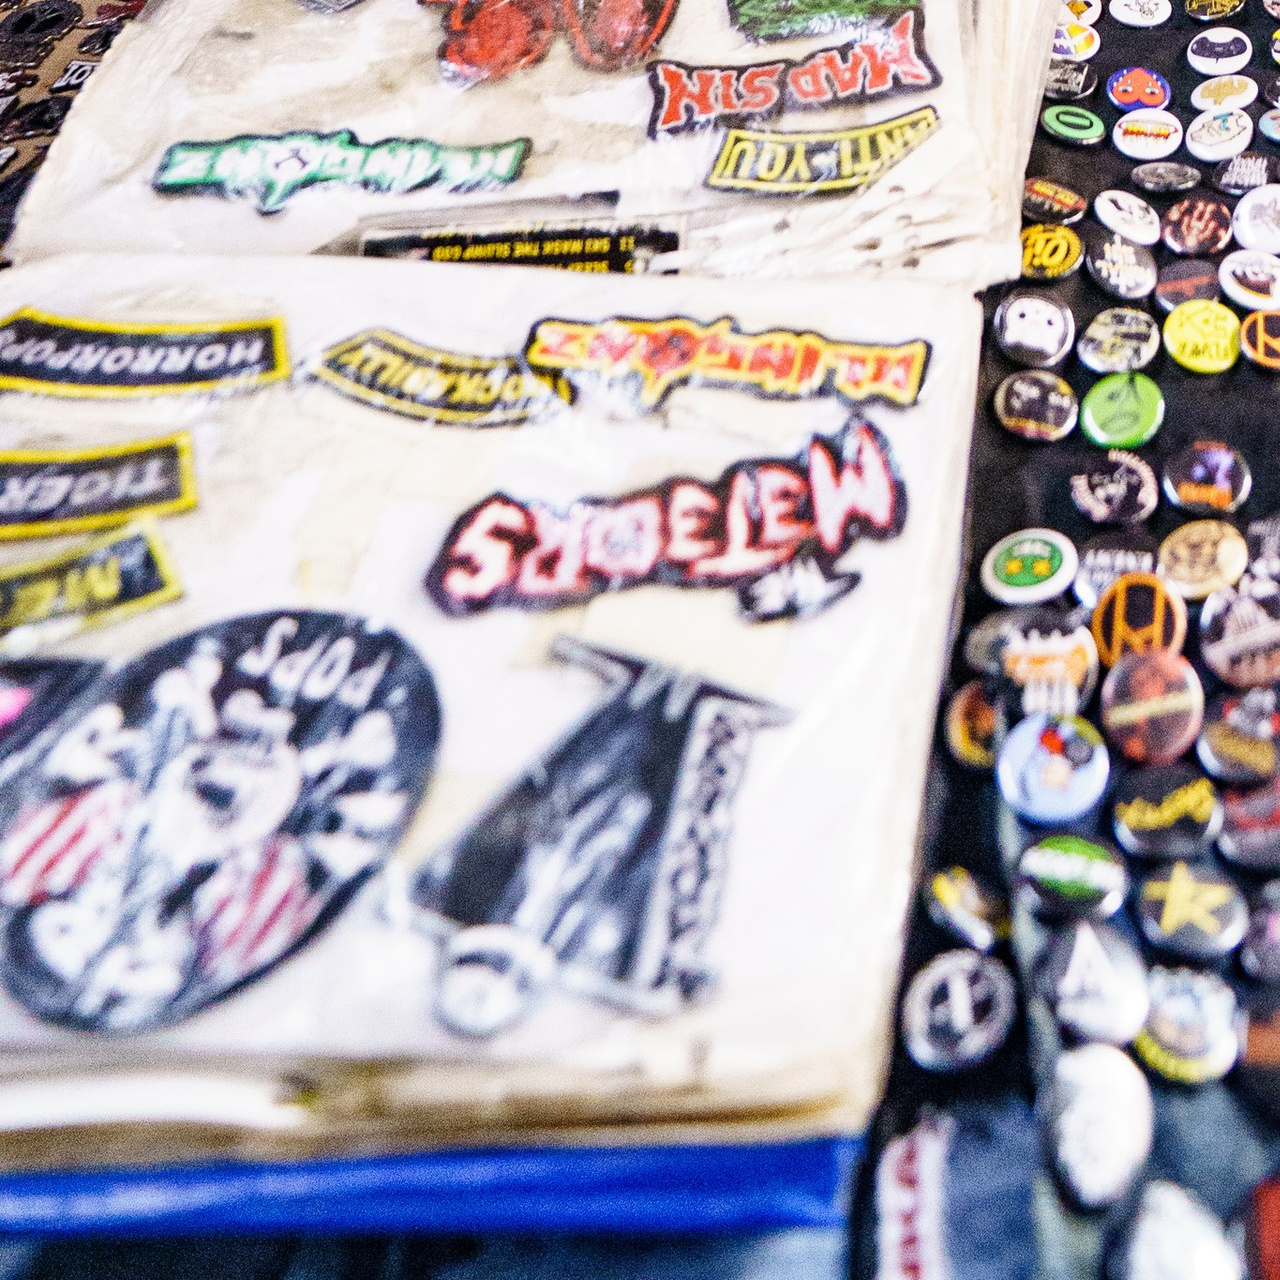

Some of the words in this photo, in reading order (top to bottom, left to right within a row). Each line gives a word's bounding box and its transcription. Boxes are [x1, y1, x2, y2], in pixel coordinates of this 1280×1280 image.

[657, 64, 783, 126] SIN
[789, 10, 928, 103] MAD
[542, 238, 584, 256] MASK
[441, 423, 897, 599] METEORS
